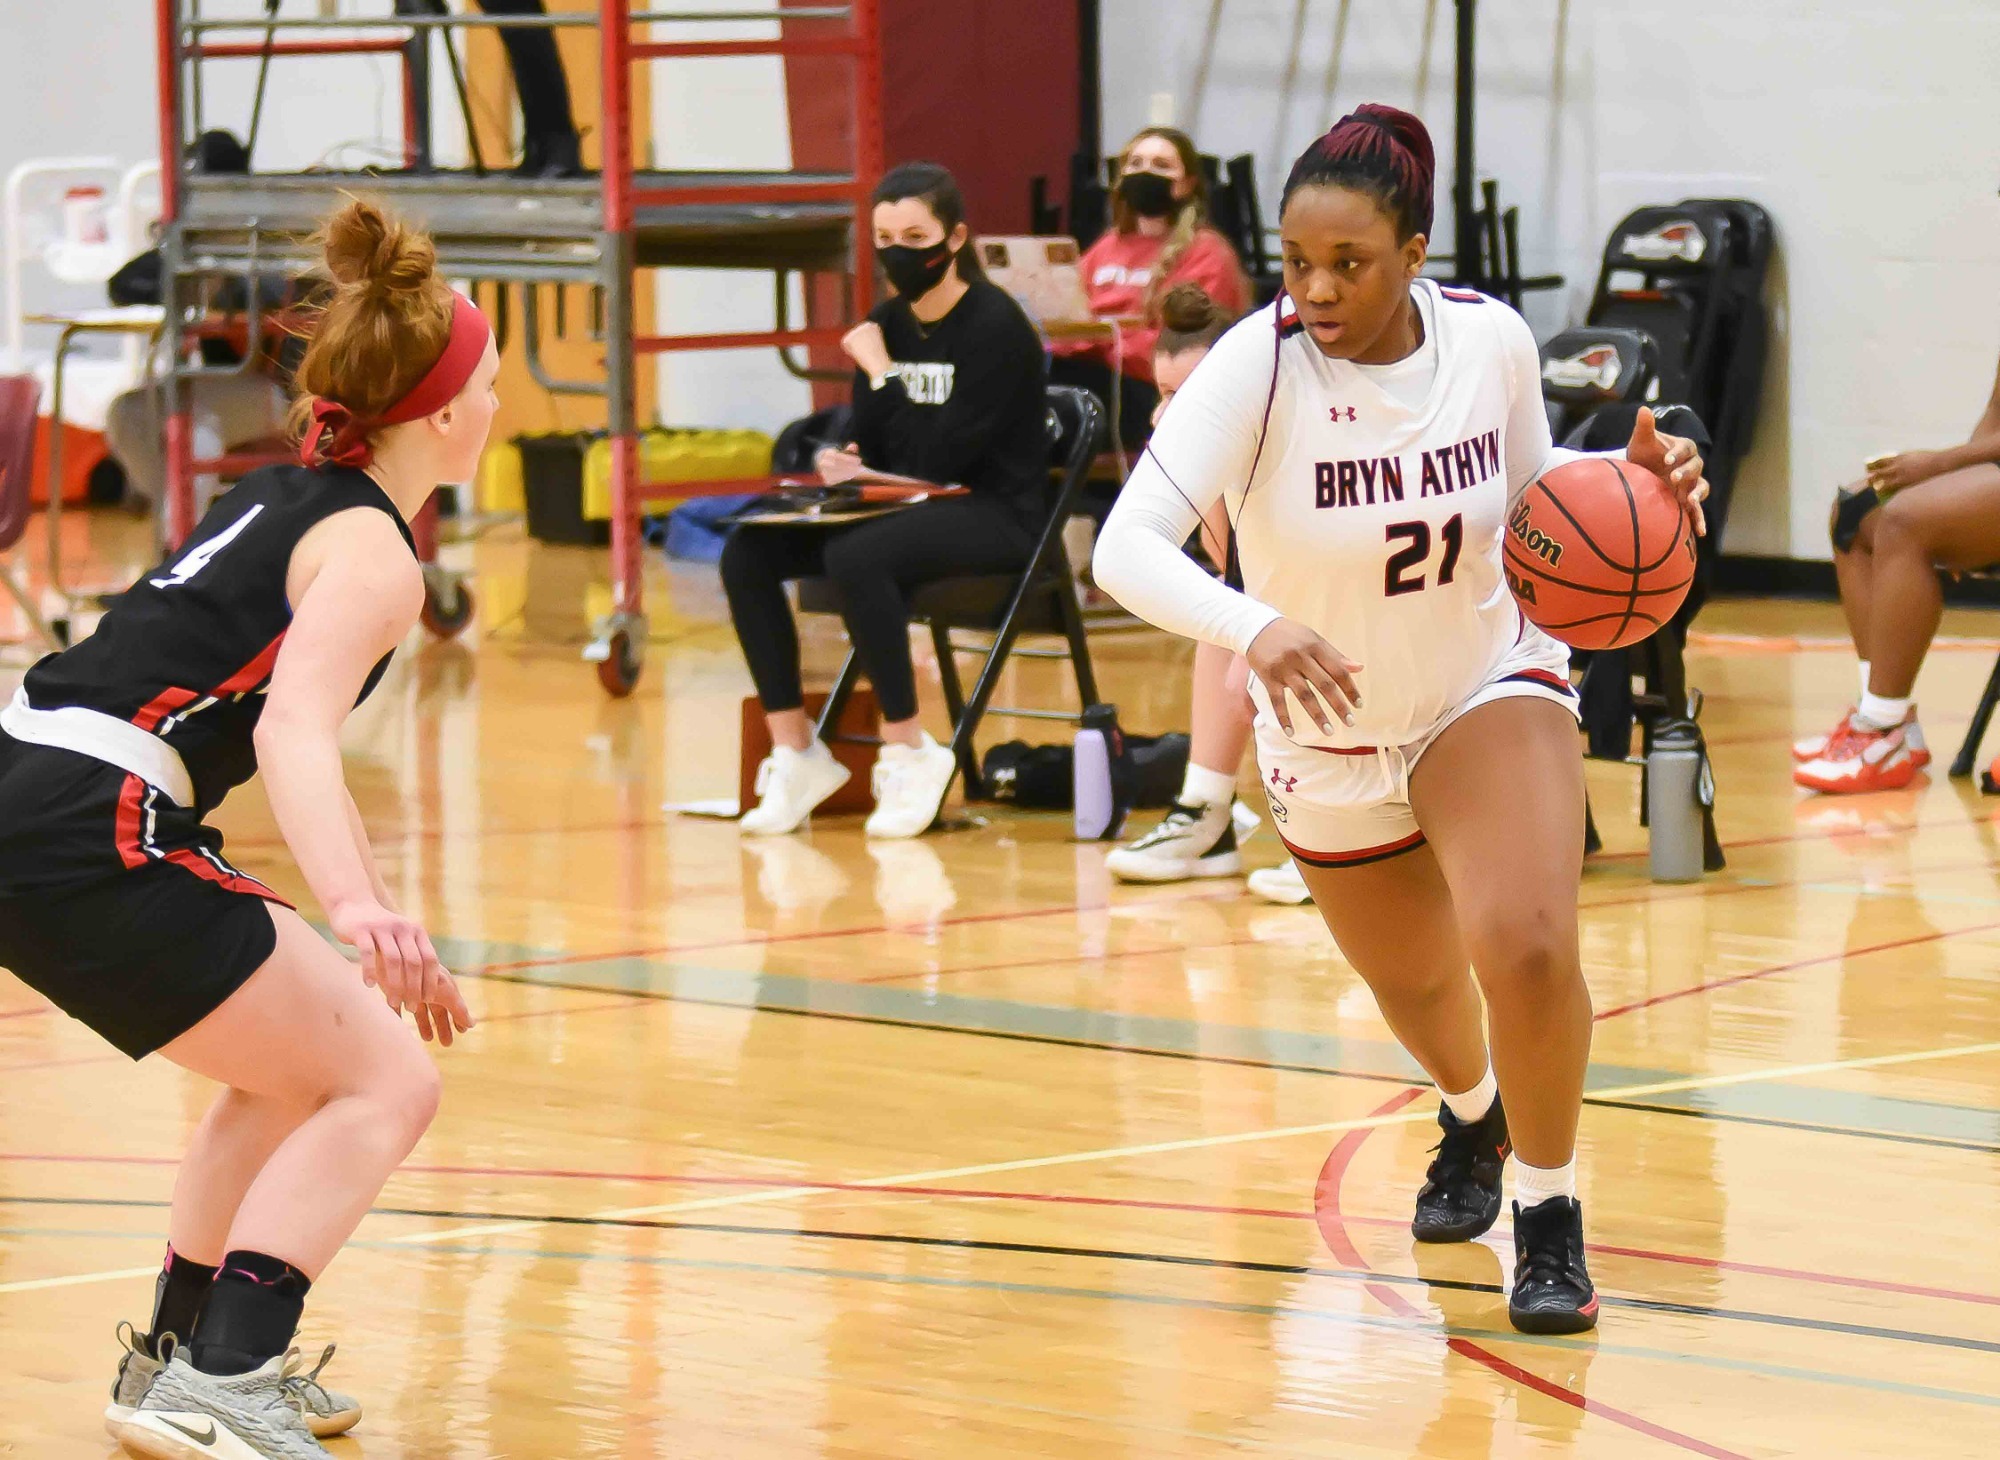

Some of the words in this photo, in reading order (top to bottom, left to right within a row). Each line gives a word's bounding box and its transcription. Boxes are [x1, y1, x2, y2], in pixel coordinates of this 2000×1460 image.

[1314, 456, 1405, 509] BRYN
[1420, 427, 1500, 498] ATHYN
[1384, 512, 1463, 597] 21
